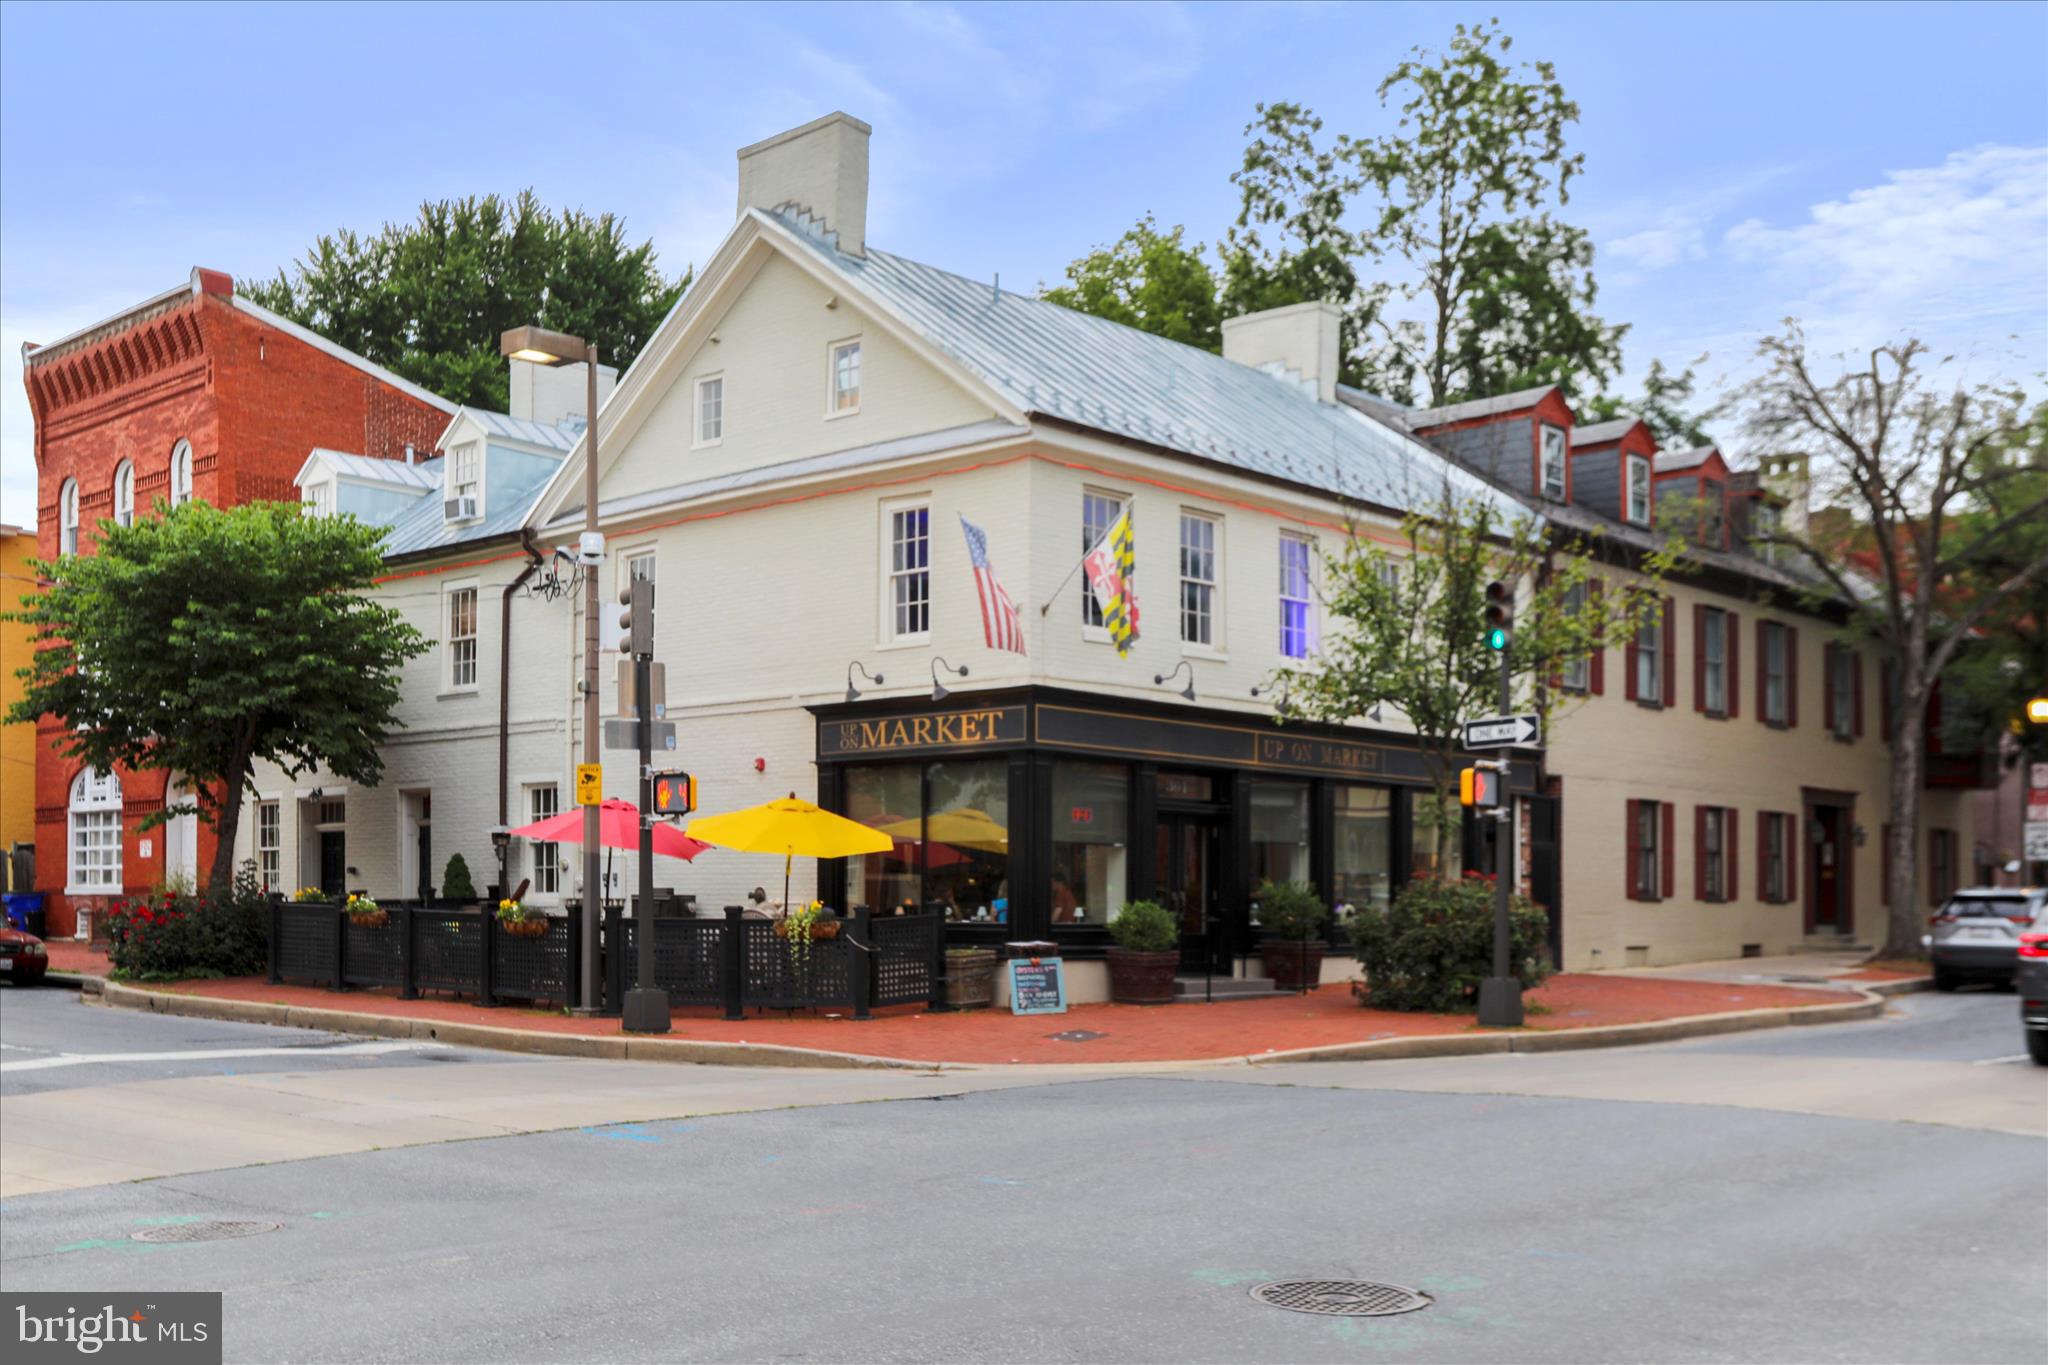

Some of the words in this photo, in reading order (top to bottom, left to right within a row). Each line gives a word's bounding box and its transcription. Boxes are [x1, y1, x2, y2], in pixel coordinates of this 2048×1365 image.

[840, 724, 857, 736] UP
[860, 711, 1003, 748] MARKET
[839, 736, 858, 749] ON
[1263, 740, 1284, 760] UP
[1291, 743, 1313, 762] ON
[1321, 744, 1378, 769] MARKET
